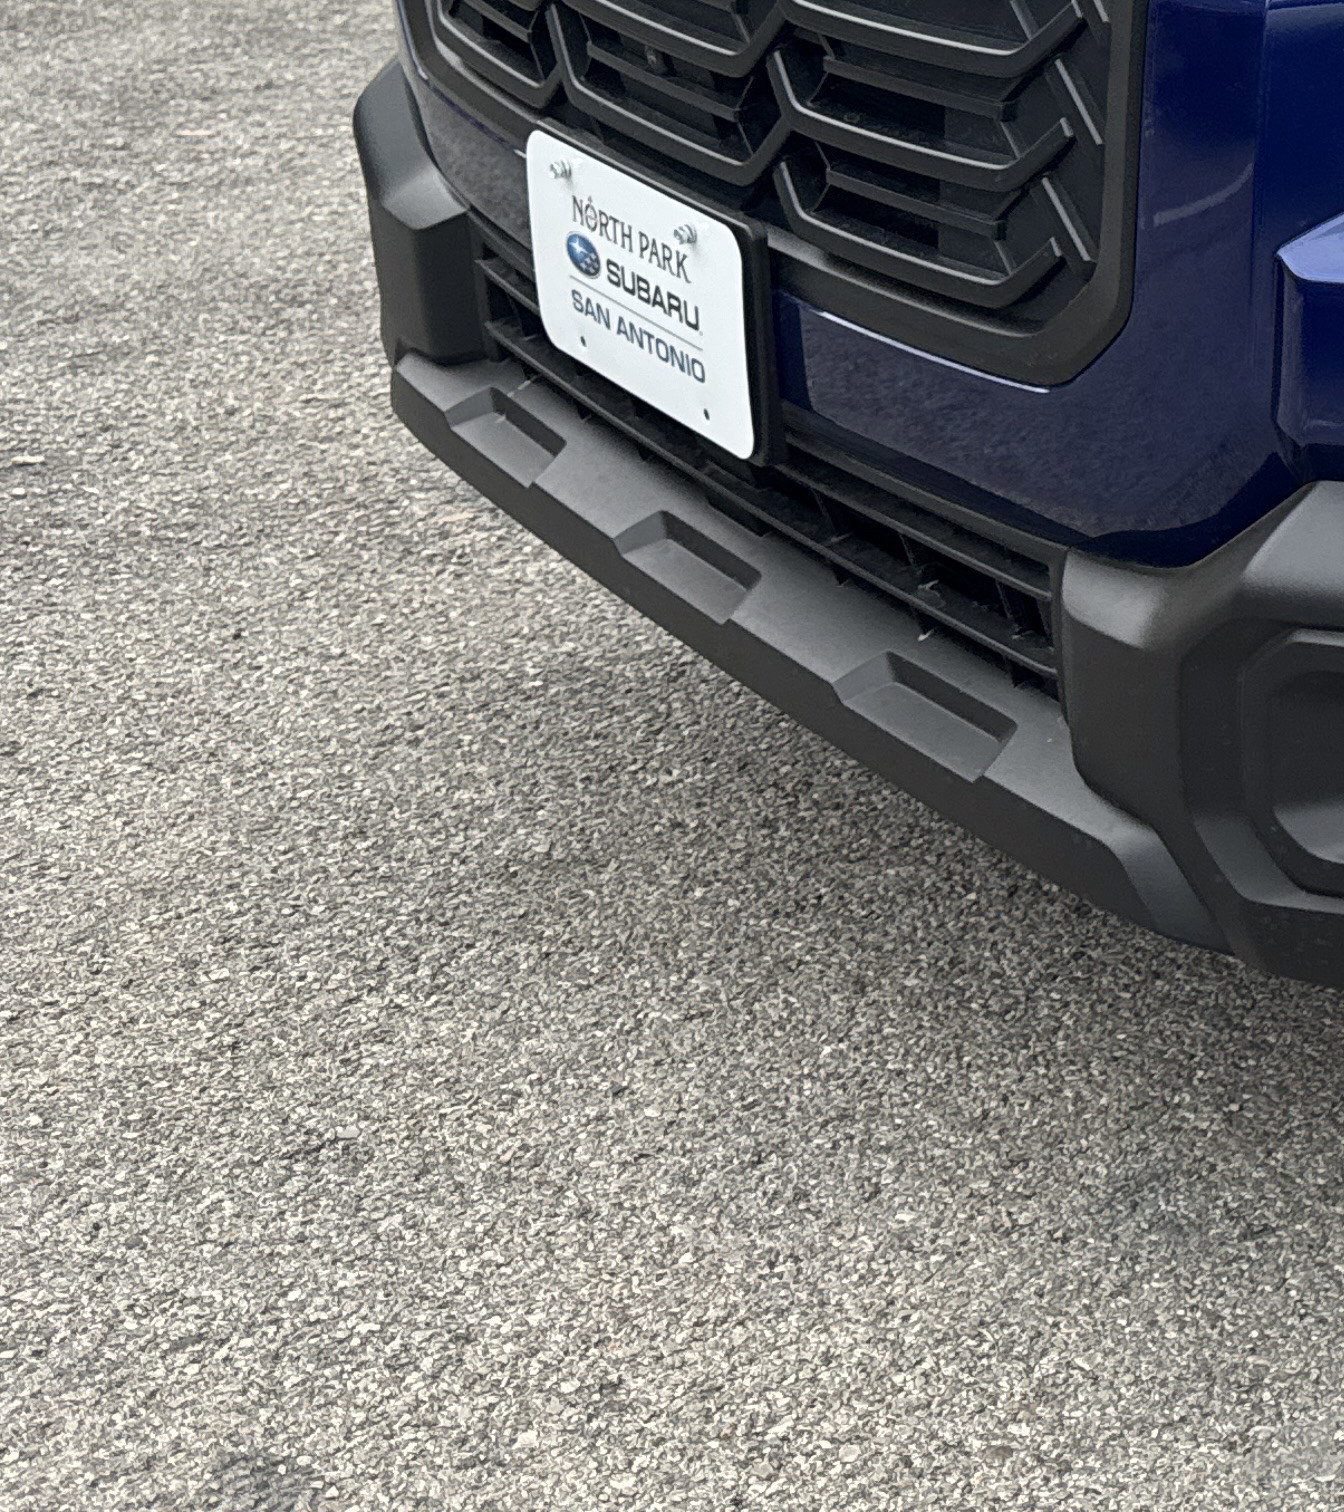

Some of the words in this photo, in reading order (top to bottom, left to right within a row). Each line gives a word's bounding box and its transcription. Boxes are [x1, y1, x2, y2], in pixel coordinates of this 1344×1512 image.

[571, 195, 634, 254] NORTH
[638, 230, 692, 284] PARK
[570, 288, 612, 331] SAN
[616, 316, 707, 384] ANTONIO
[605, 258, 701, 332] SUBARU
